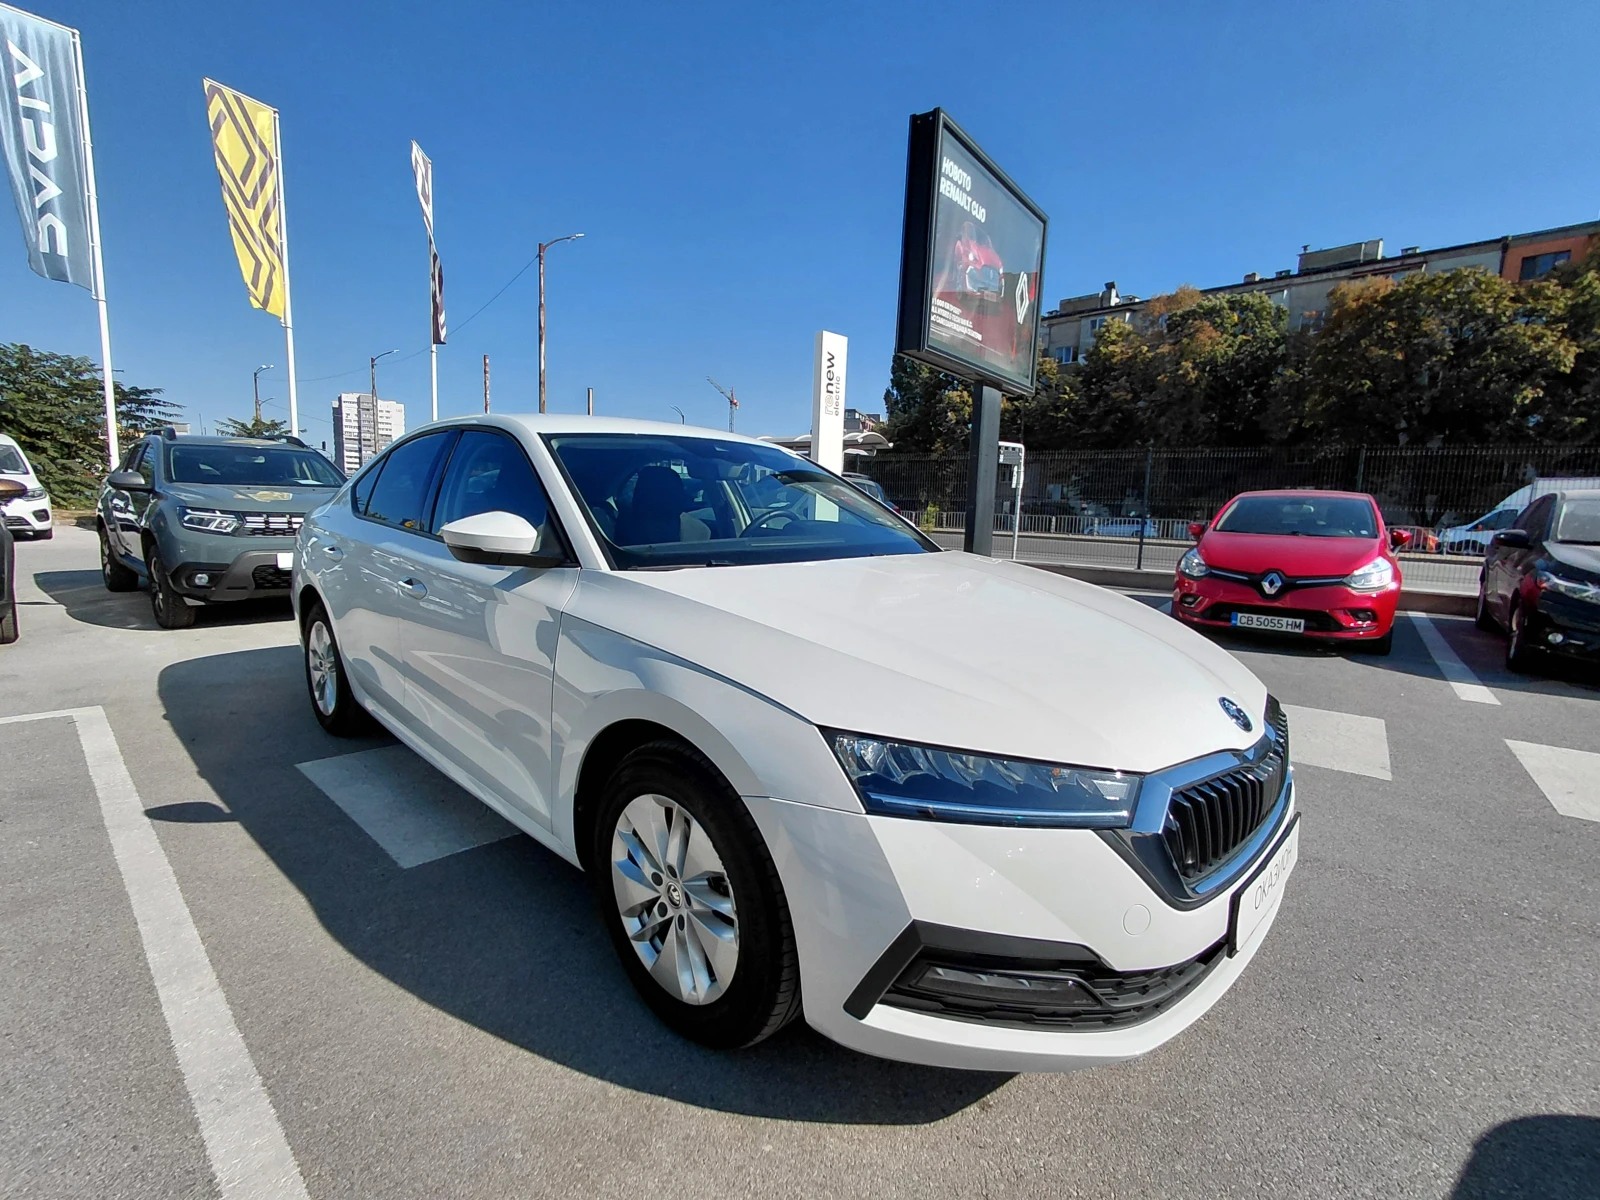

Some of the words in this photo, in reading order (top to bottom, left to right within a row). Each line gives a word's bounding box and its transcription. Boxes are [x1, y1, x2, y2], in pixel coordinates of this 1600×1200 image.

[942, 156, 971, 192] НОВОТО
[940, 177, 972, 212] RENAULT
[971, 200, 986, 223] CLIO
[825, 351, 835, 415] renew
[1239, 615, 1254, 626] CB
[1256, 617, 1284, 629] 5055
[1285, 619, 1302, 631] HM
